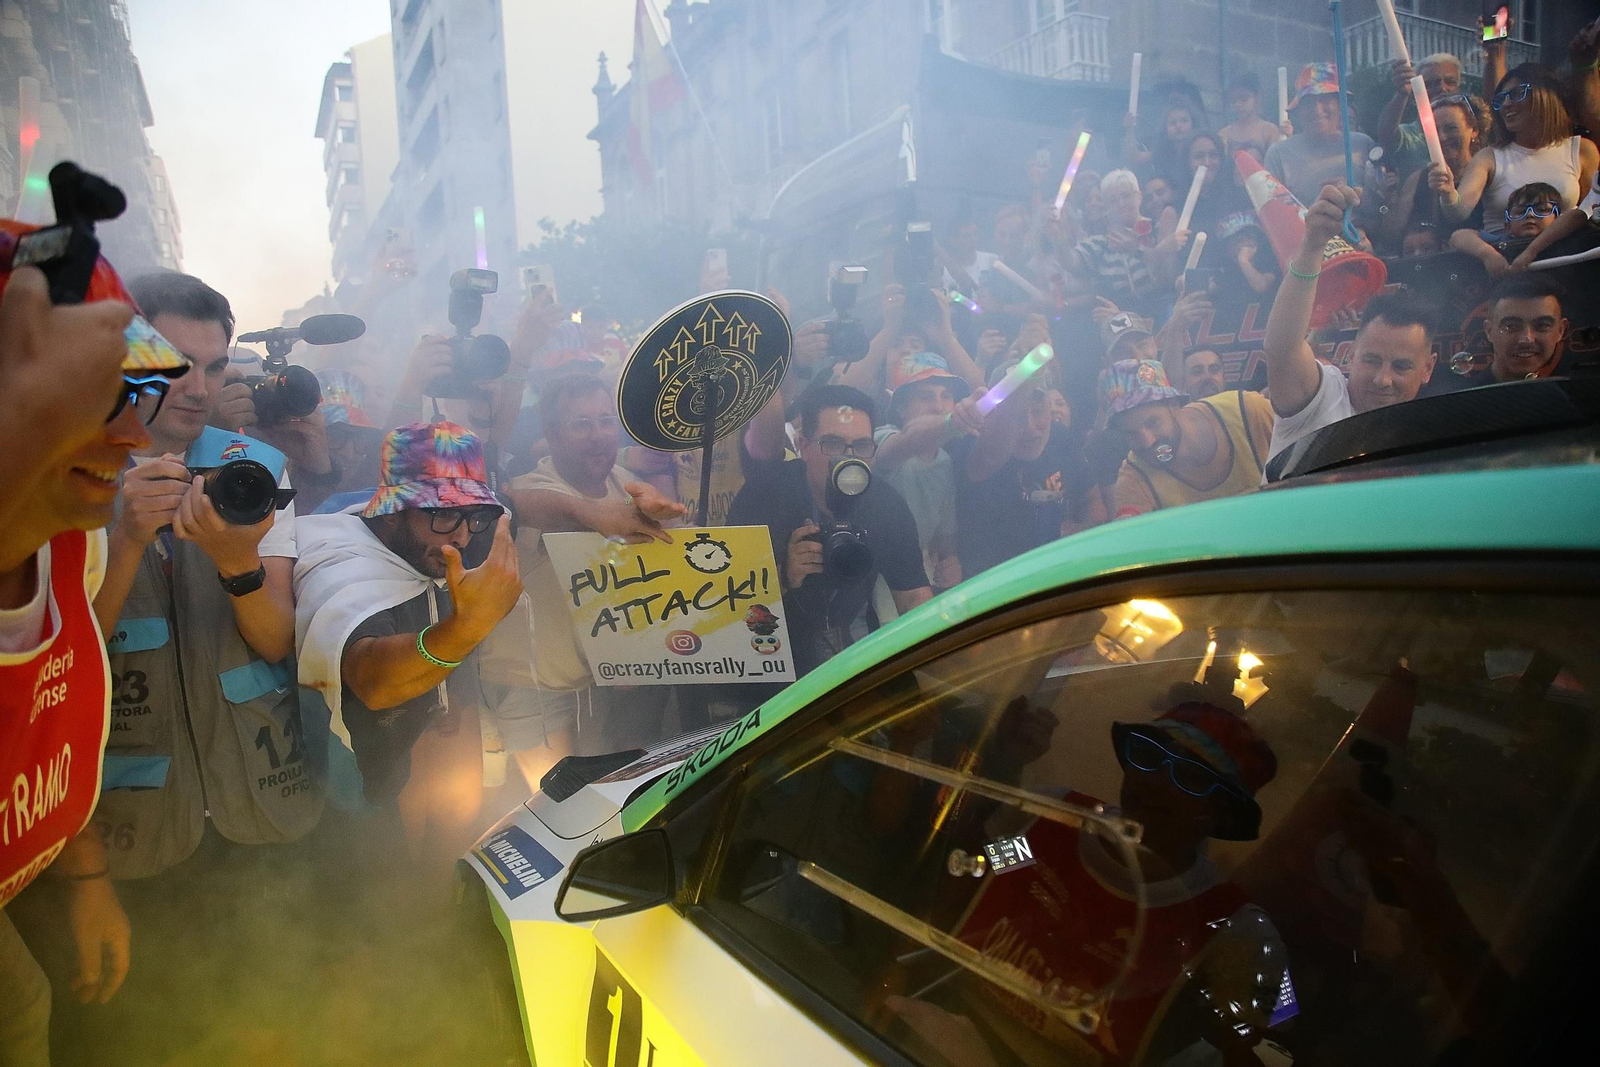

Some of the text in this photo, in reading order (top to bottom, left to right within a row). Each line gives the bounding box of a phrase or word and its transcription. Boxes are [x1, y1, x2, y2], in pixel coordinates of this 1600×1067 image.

[661, 379, 684, 418] CRAZY
[569, 555, 671, 607] FULL
[590, 567, 769, 638] ATTACK!!
[598, 657, 786, 680] @crazyfansrally_ou
[488, 839, 546, 888] MICHELIN
[1013, 836, 1033, 862] N
